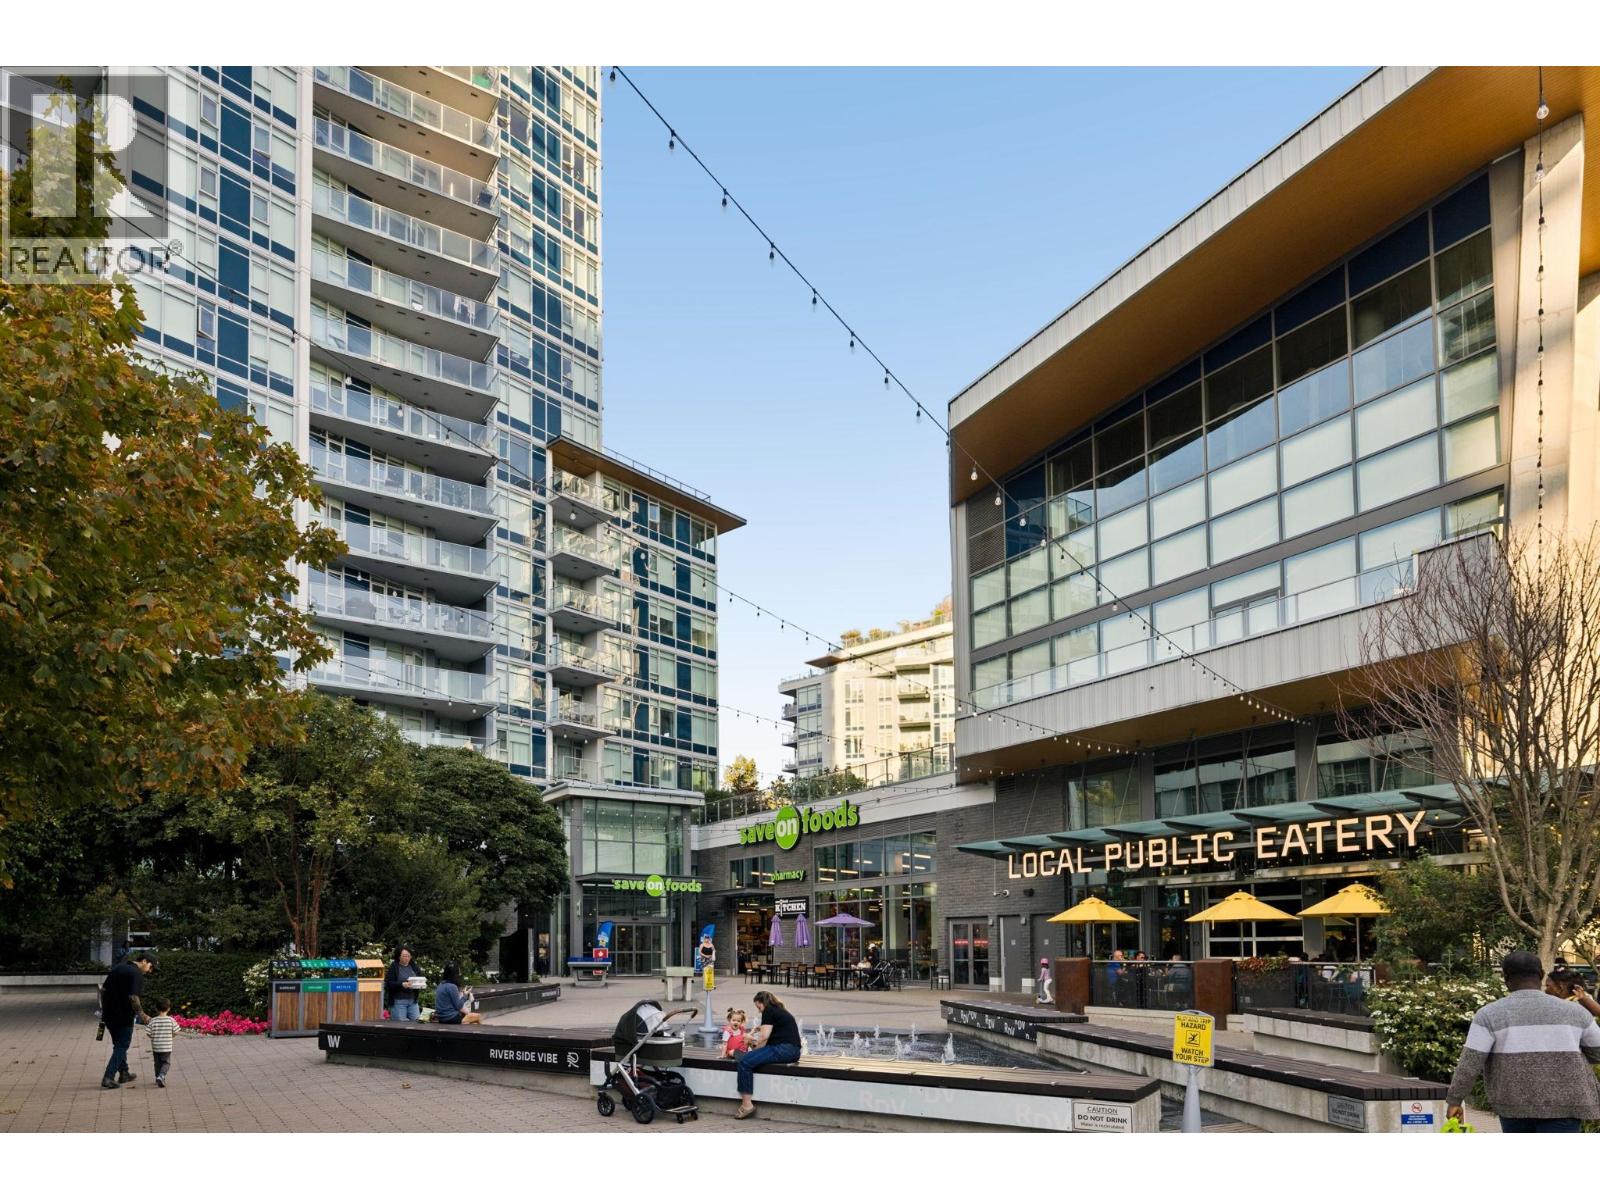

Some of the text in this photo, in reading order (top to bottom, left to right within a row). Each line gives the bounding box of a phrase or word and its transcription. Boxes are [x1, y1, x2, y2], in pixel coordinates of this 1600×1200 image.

[740, 799, 859, 845] save on foods
[1007, 810, 1427, 880] LOCAL PUBLIC EATERY
[770, 870, 804, 884] pharmacy
[613, 878, 702, 893] save on foods
[775, 900, 806, 914] KITCHEN
[1181, 1022, 1206, 1031] HAZARD
[489, 1048, 515, 1061] RIVER
[515, 1050, 536, 1062] SIDE
[537, 1052, 558, 1064] VIBE
[1175, 1053, 1210, 1064] YOUR STEP
[1181, 1047, 1204, 1057] WATCH
[1087, 1106, 1118, 1114] CAUTION
[1106, 1116, 1128, 1125] DRINK
